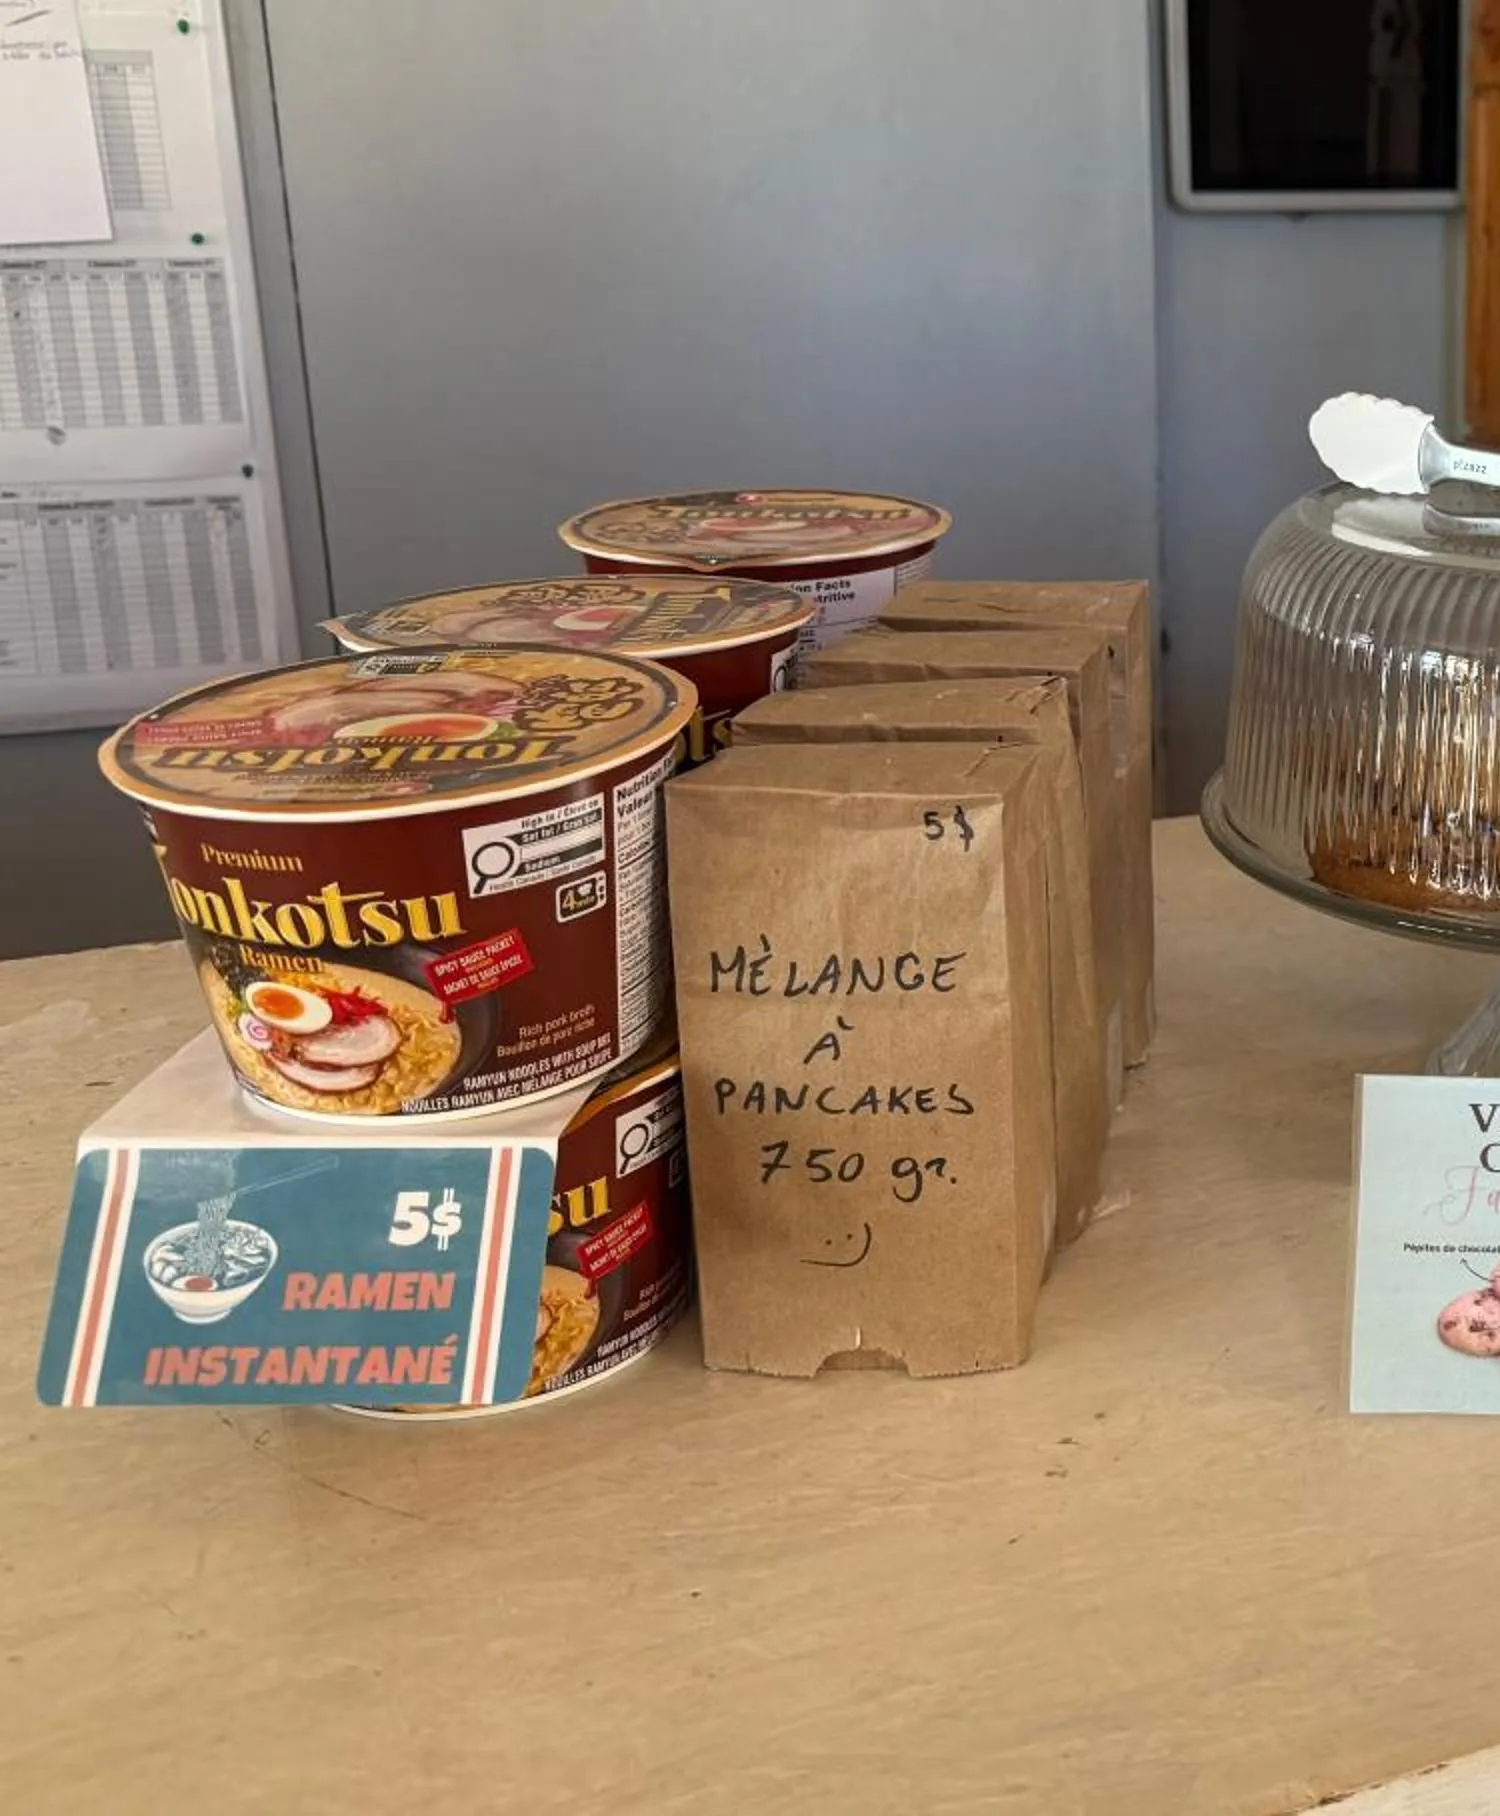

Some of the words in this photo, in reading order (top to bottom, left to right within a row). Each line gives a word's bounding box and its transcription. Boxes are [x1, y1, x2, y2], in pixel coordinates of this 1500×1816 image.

[816, 579, 851, 592] Facts
[200, 843, 304, 872] Premium
[170, 875, 468, 950] onkotsu
[239, 943, 325, 974] Ramen
[714, 1076, 976, 1116] PANCAKES
[759, 1139, 866, 1186] 750
[387, 1188, 463, 1252] 5$
[281, 1271, 456, 1313] RAMEN
[143, 1335, 461, 1388] INSTANTANÉ
